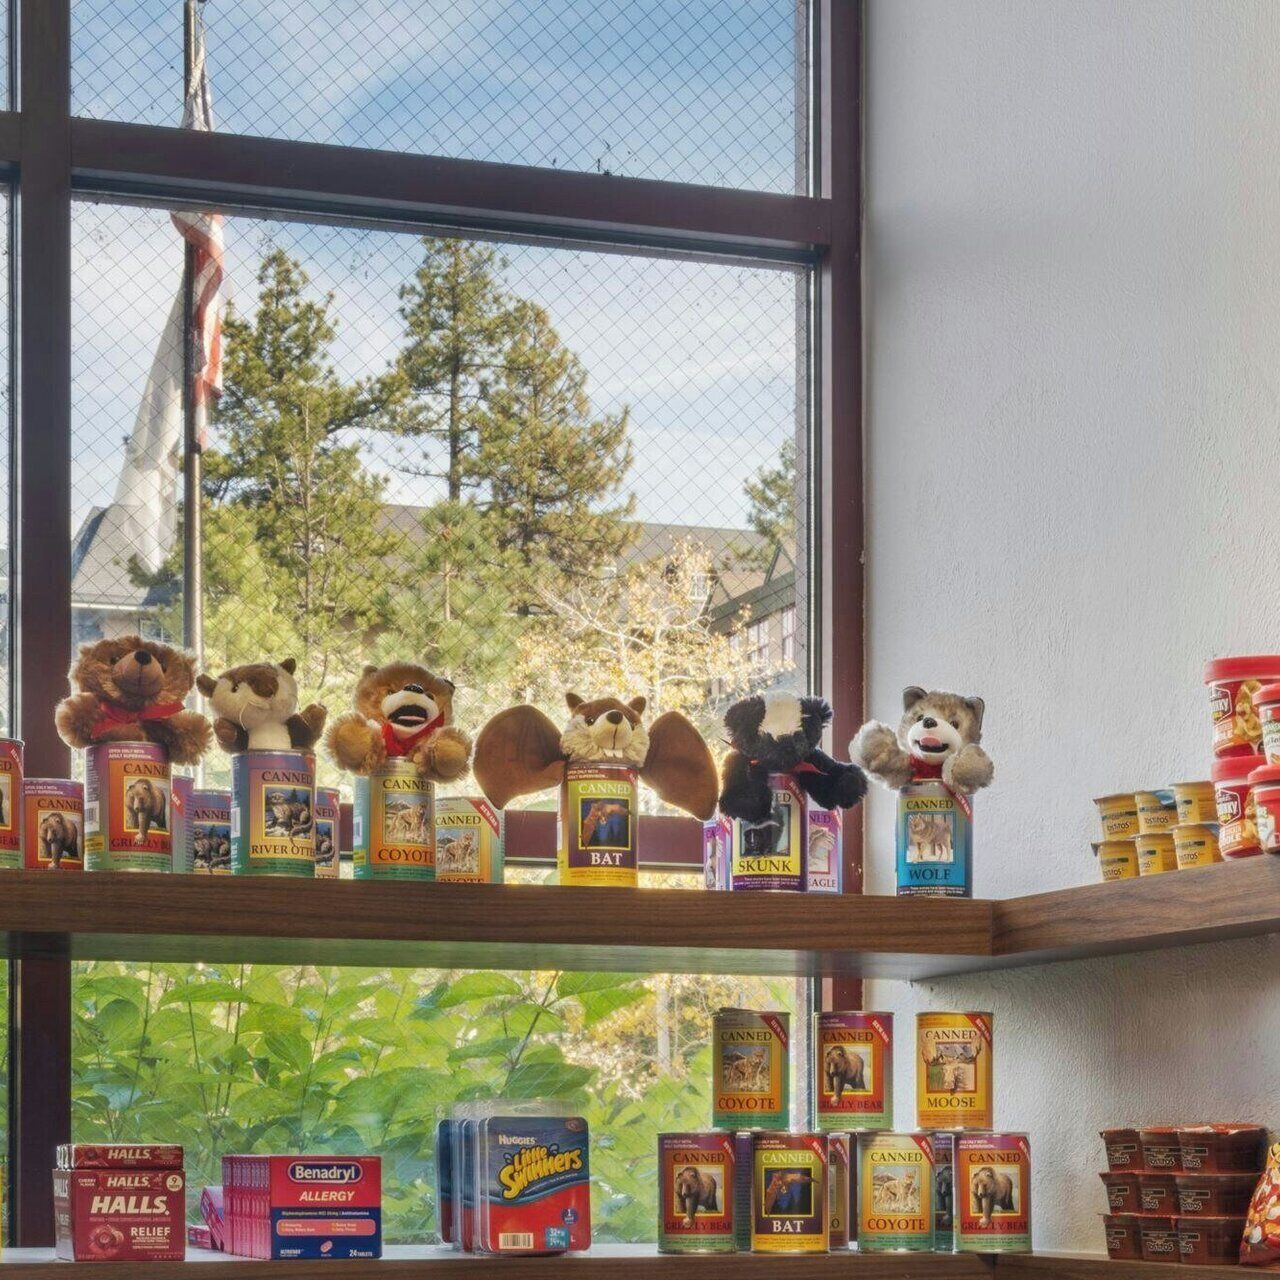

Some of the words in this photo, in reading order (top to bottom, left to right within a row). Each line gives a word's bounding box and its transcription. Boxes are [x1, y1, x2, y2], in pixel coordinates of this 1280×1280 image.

[906, 800, 954, 810] CANNED
[252, 844, 289, 856] RIVER
[590, 853, 622, 866] BAT
[738, 859, 792, 873] SKUNK
[908, 868, 952, 881] WOLF
[718, 1096, 775, 1110] COYOTE
[927, 1096, 976, 1109] MOOSE
[498, 1135, 536, 1145] HUGGIES
[295, 1165, 355, 1183] Benadryl
[299, 1191, 355, 1202] ALLERGY
[771, 1218, 804, 1234] BAT
[867, 1217, 926, 1231] COYOTE
[131, 1227, 171, 1237] RELIEF
